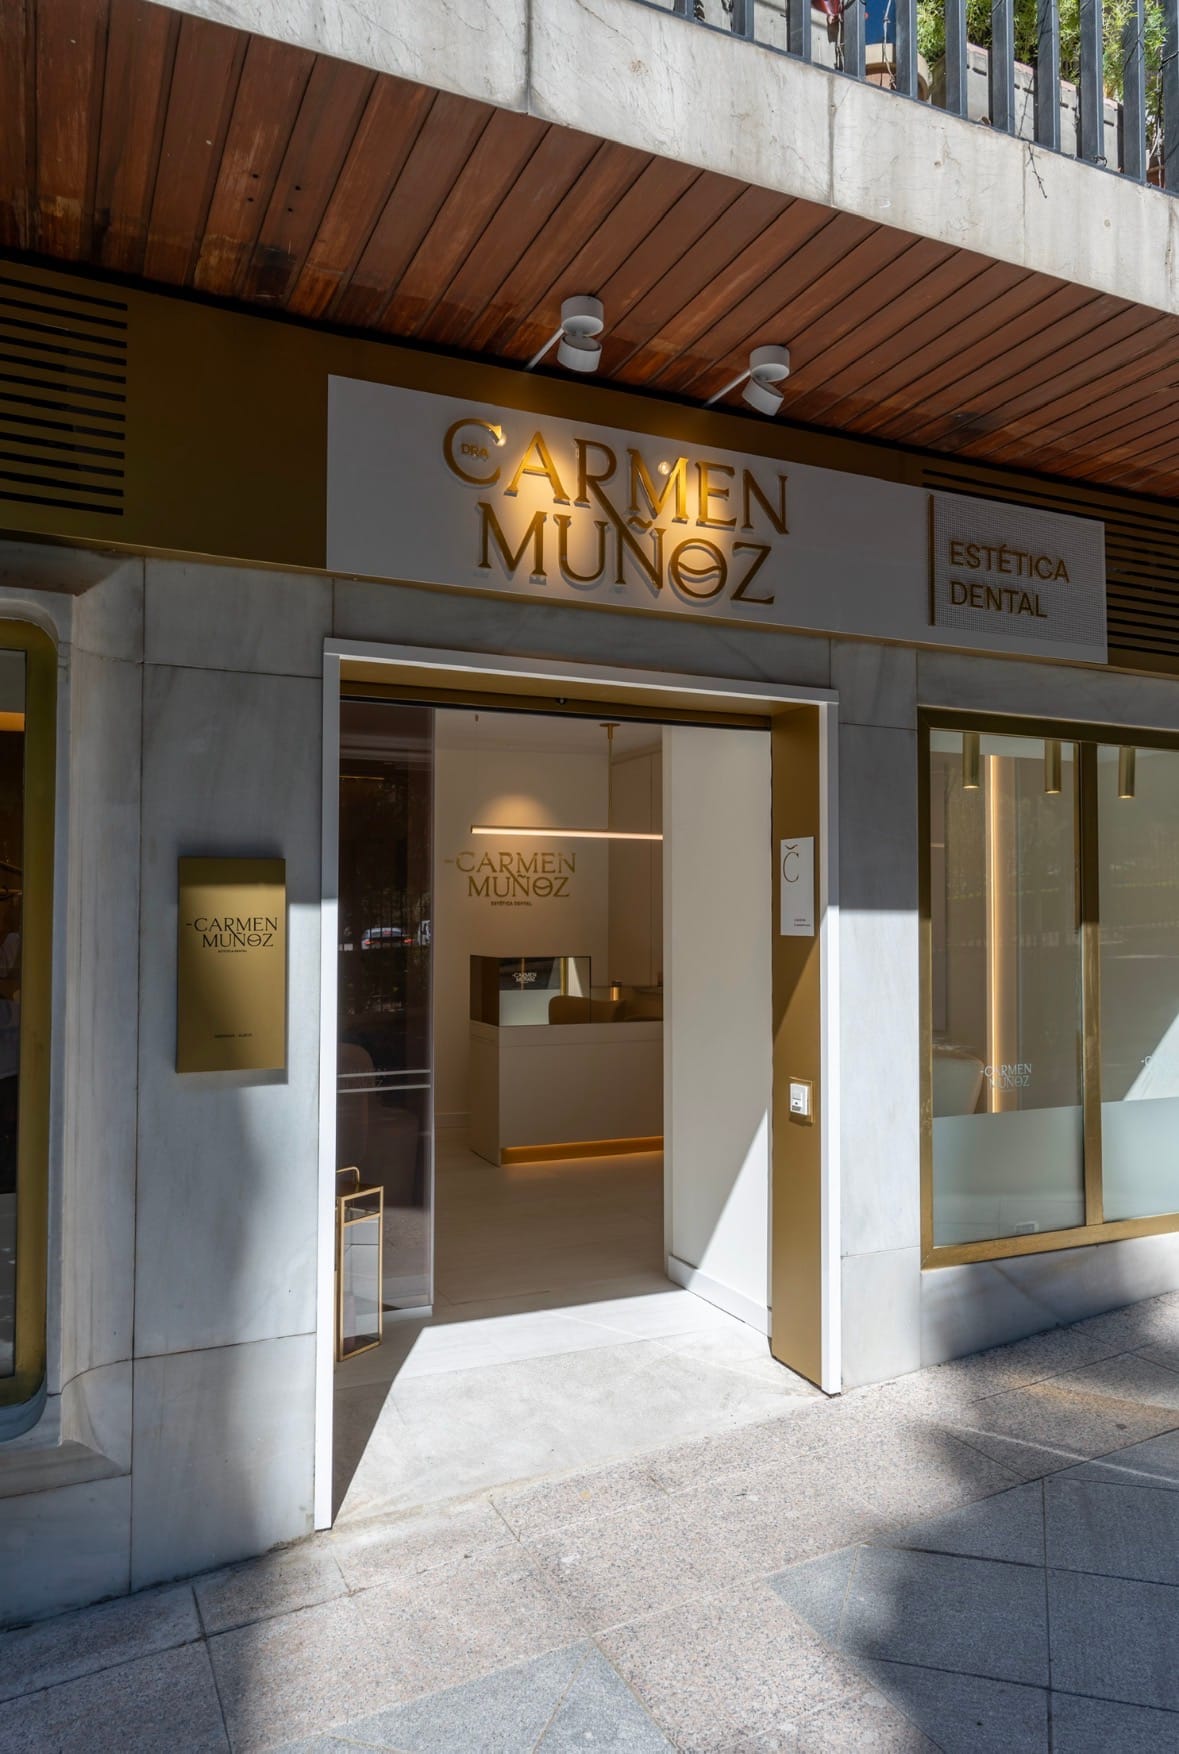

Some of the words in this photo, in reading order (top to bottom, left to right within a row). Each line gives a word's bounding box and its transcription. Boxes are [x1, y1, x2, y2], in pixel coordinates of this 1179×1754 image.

[443, 417, 788, 535] CARMEN
[478, 501, 775, 605] MUÑOZ
[949, 540, 1070, 584] ESTÉTICA
[950, 580, 1048, 618] DENTAL
[455, 851, 576, 874] CARMEN
[467, 873, 570, 898] MUÑOZ
[193, 917, 278, 932] CARMEN
[202, 932, 274, 948] MUÑOZ
